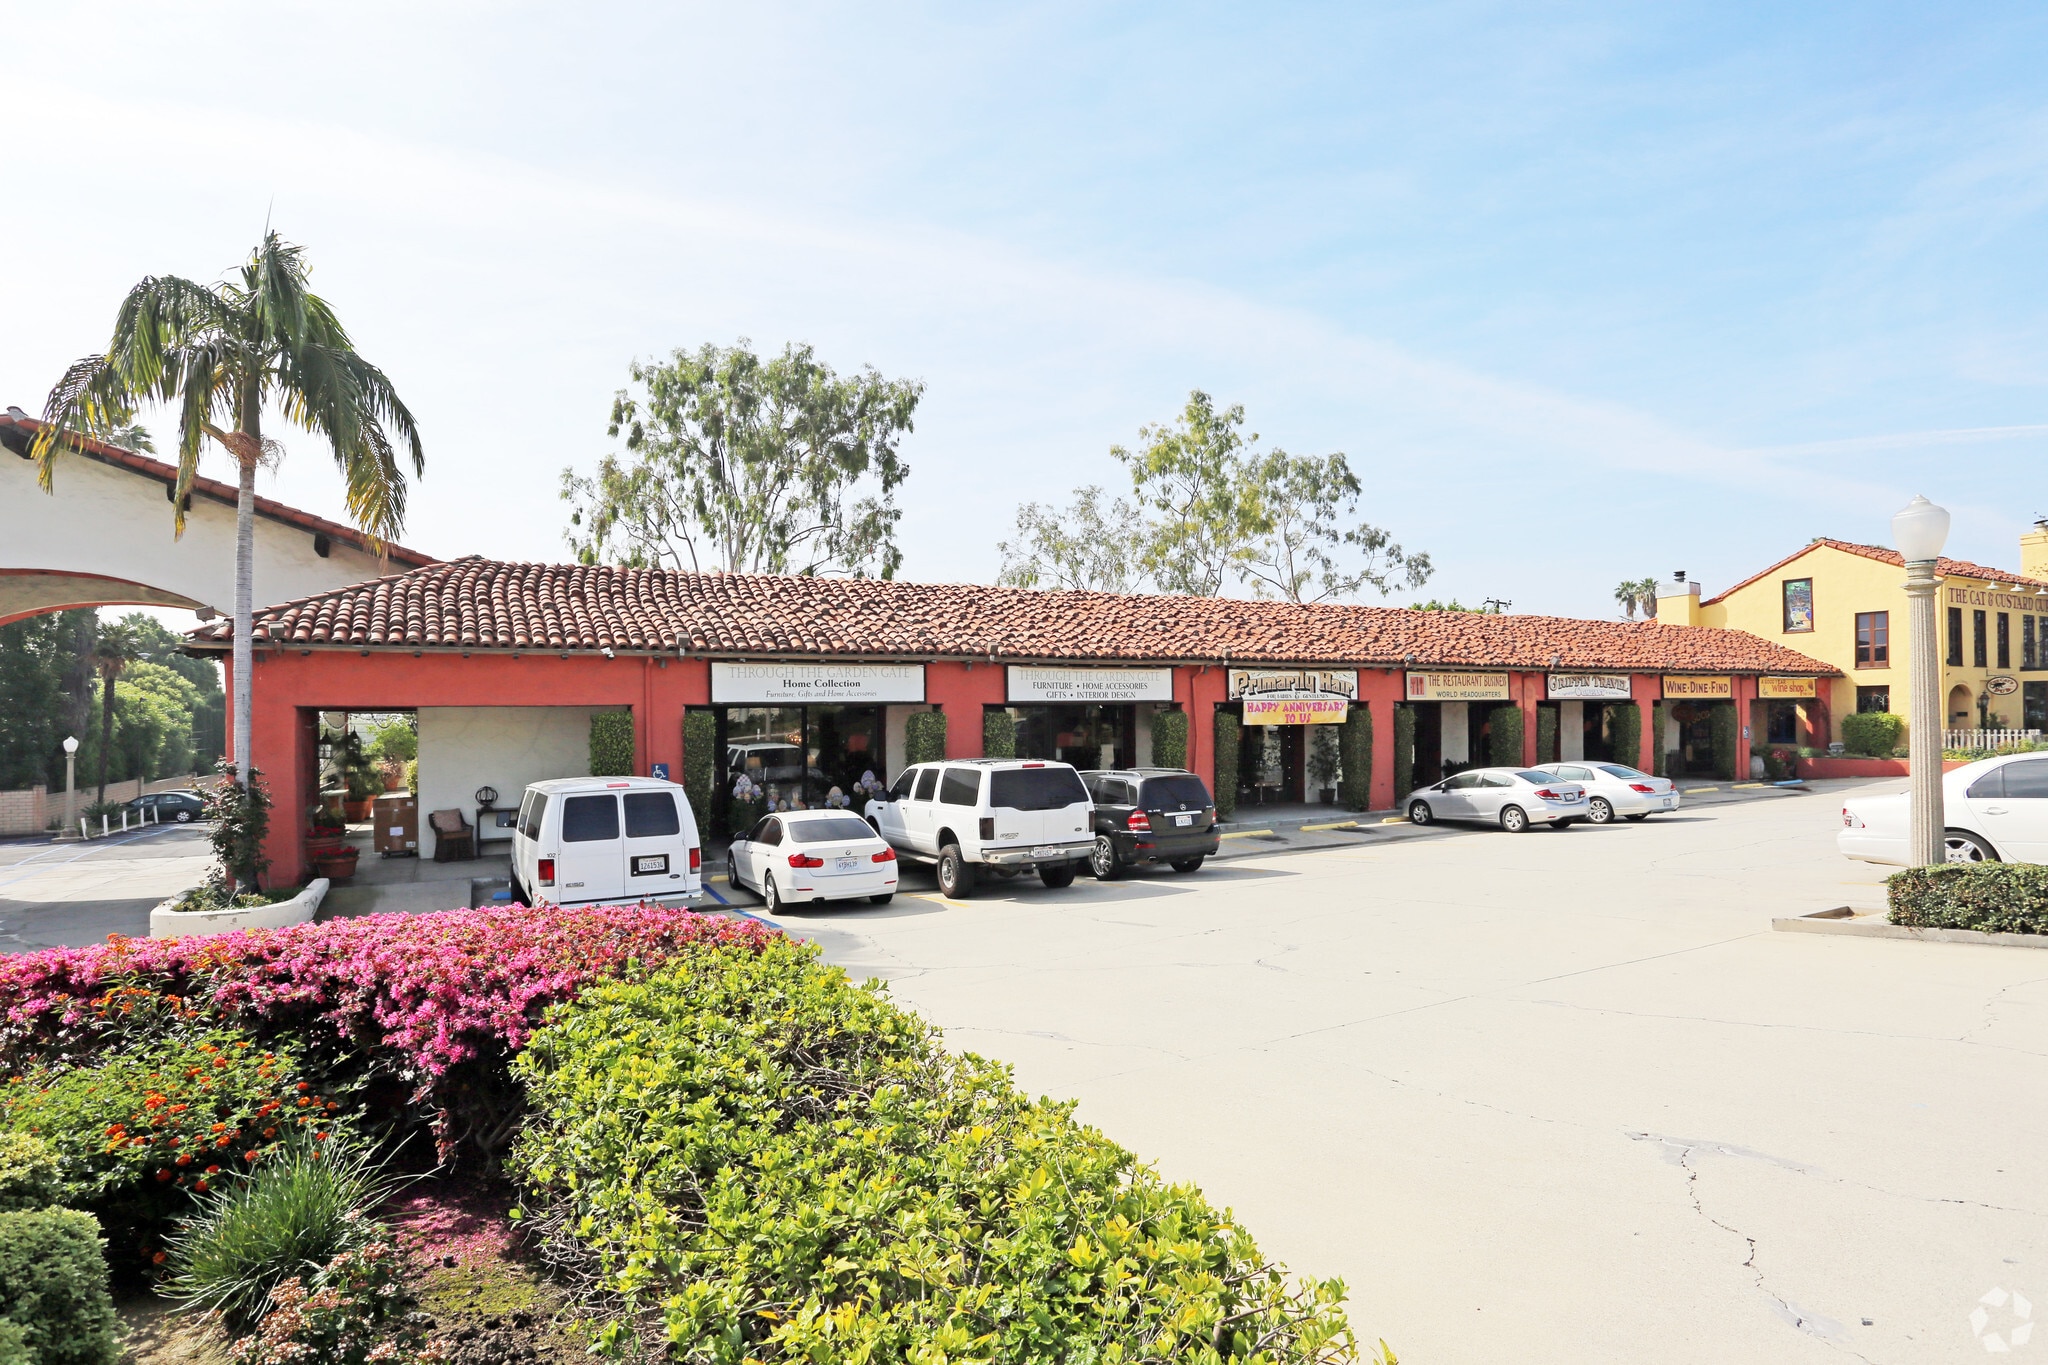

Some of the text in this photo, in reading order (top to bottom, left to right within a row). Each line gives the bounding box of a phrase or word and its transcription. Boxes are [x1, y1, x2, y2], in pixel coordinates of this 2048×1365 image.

[1949, 588, 1967, 604] THE
[1970, 591, 1986, 605] CAT
[1988, 592, 1994, 606] &
[1995, 593, 2034, 611] CUSTARD
[729, 667, 910, 678] THROUGH THE GARDEN GATE
[1019, 670, 1160, 682] THROUGH THE GARDEN GATE
[783, 679, 861, 688] Home Collection
[1032, 682, 1148, 690] FURNITURE HOME ACCESSORIES
[1230, 671, 1354, 700] Primarily Hair
[1427, 674, 1440, 687] THE
[1443, 675, 1482, 687] RESTAURANT
[1549, 675, 1629, 692] GRIFFIN TRAVEL
[1665, 680, 1728, 693] WINE DINE FIND
[1772, 684, 1788, 693] wine
[798, 690, 813, 698] Gifts
[1046, 691, 1136, 699] GIFTS INTERIOR DESIGN
[1436, 690, 1457, 698] WORLD
[1247, 701, 1346, 713] HAPPY ANNIVERSARY
[1285, 713, 1311, 724] TO US
